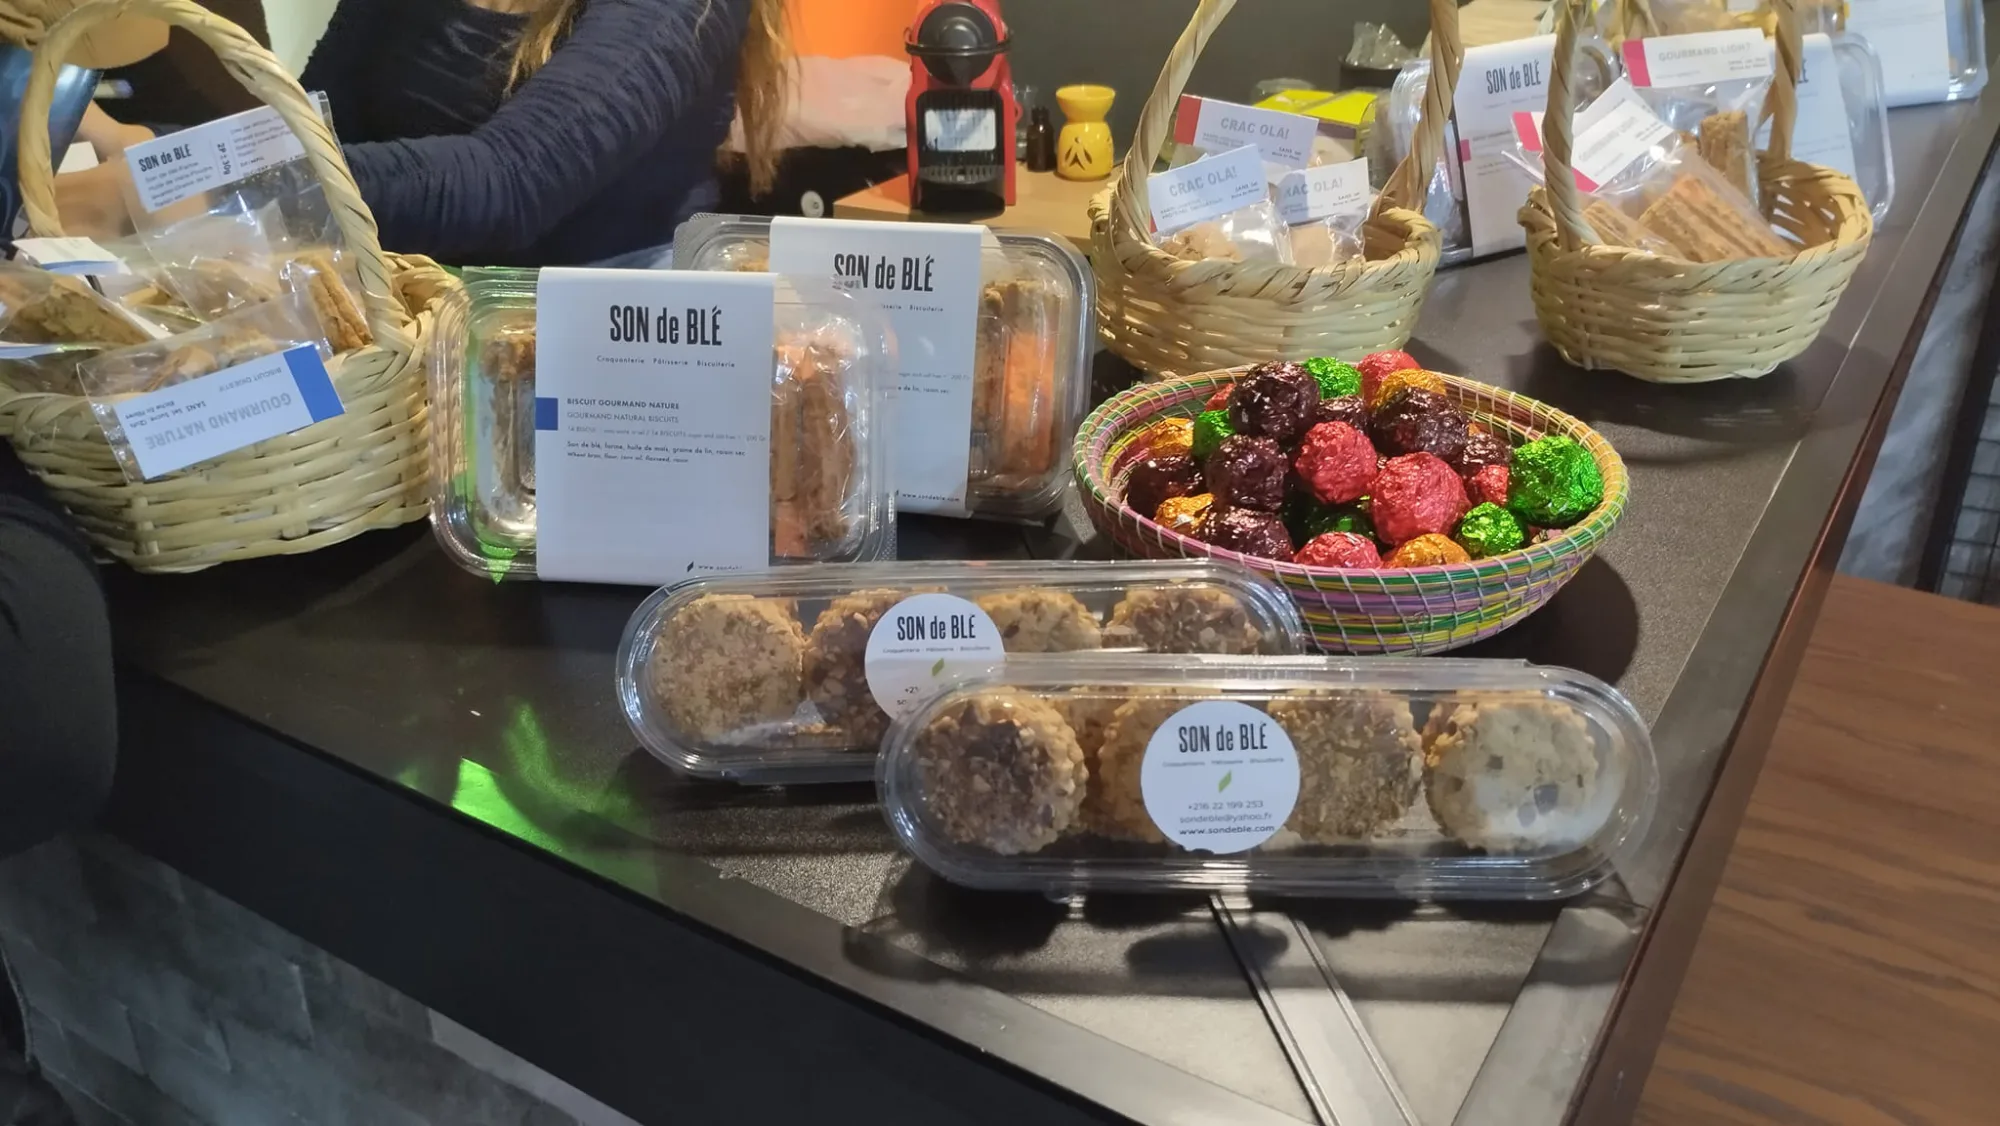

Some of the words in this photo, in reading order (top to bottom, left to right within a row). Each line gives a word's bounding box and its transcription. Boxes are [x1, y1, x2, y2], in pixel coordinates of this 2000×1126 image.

[1485, 66, 1508, 95] SON
[1509, 65, 1522, 91] de
[1220, 117, 1256, 134] CRAC
[138, 154, 160, 172] SON
[160, 151, 173, 165] de
[1168, 176, 1204, 198] CRAC
[1207, 165, 1238, 186] OLA!
[874, 255, 896, 290] de
[901, 253, 935, 292] BLÉ
[609, 304, 649, 342] SON
[656, 307, 679, 345] de
[686, 304, 723, 346] BLÉ
[596, 355, 645, 365] Croquanterie
[696, 359, 736, 369] Biscuiterie
[208, 392, 292, 430] GOURMAND
[567, 397, 596, 406] BISCUIT
[598, 399, 647, 409] GOURMAND
[649, 401, 680, 410] NATURE
[567, 411, 613, 421] GOURMAND
[613, 413, 646, 422] NATURAL
[648, 415, 679, 424] BISCUITS
[145, 419, 205, 450] NATURE
[896, 615, 925, 641] SON
[930, 615, 946, 640] de
[1178, 725, 1211, 753] SON
[1215, 724, 1234, 751] de
[1212, 801, 1224, 810] 22
[1226, 801, 1244, 809] 199
[1246, 800, 1263, 809] 253
[1179, 811, 1272, 824] sondeble@yahoo.fr
[1179, 825, 1275, 835] www.sondeble.com
